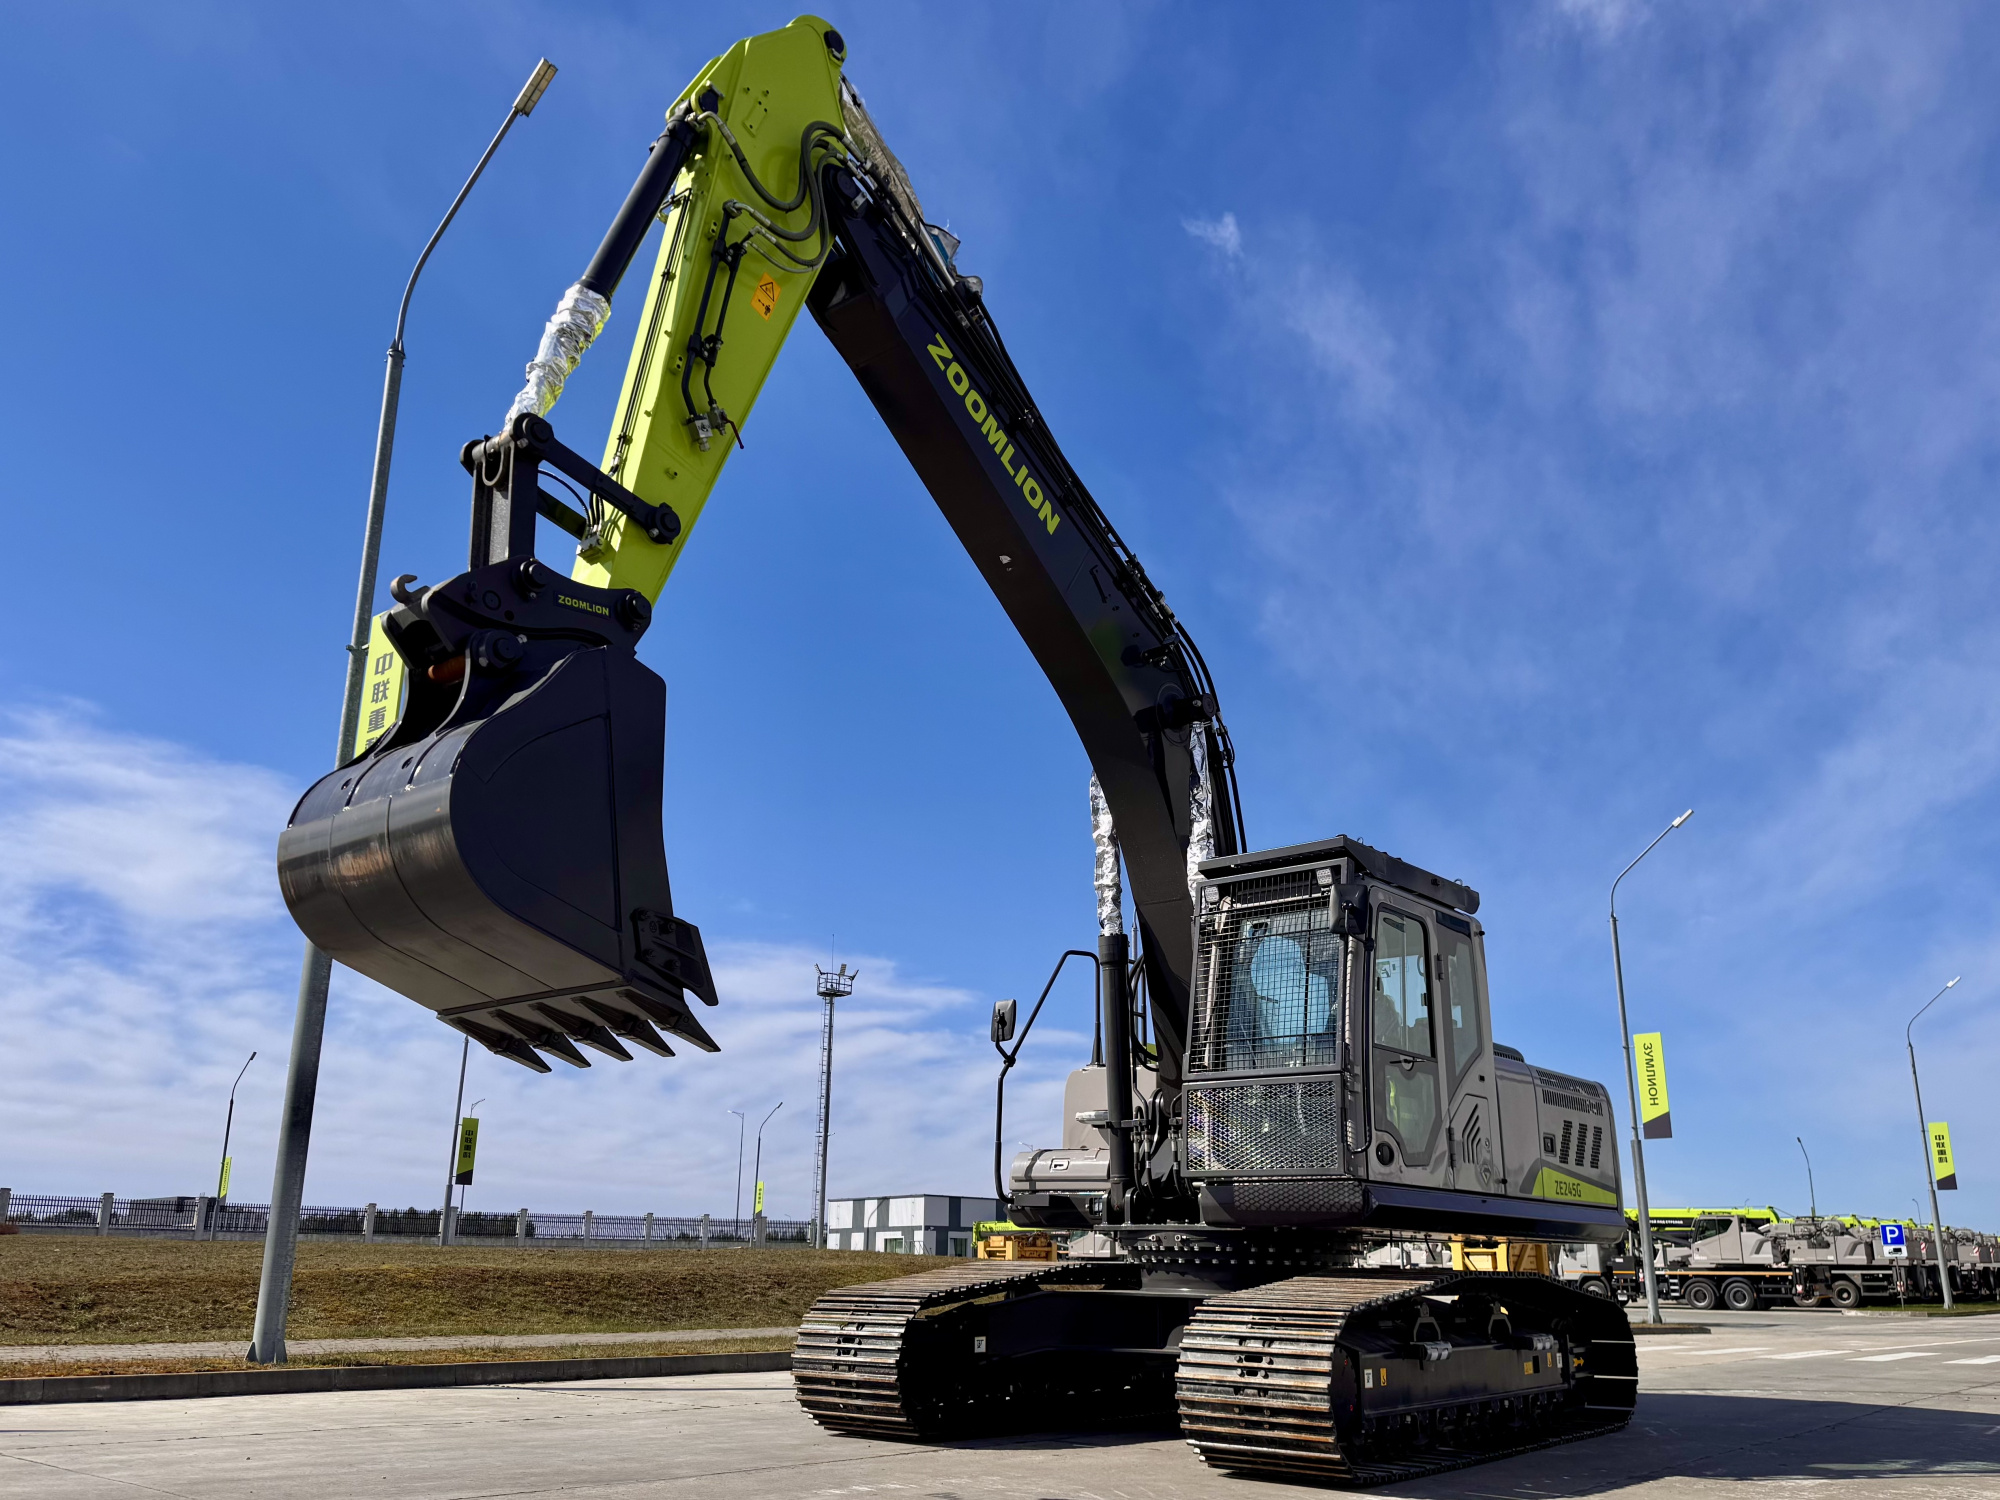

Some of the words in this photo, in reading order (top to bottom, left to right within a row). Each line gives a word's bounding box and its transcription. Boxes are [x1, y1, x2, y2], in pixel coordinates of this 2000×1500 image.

[927, 332, 1061, 535] ZOOMLION
[558, 594, 609, 616] ZOOMLION
[1643, 1042, 1659, 1106] ЗУМЛИОН
[1555, 1180, 1582, 1197] ZE245G
[1885, 1226, 1899, 1244] P
